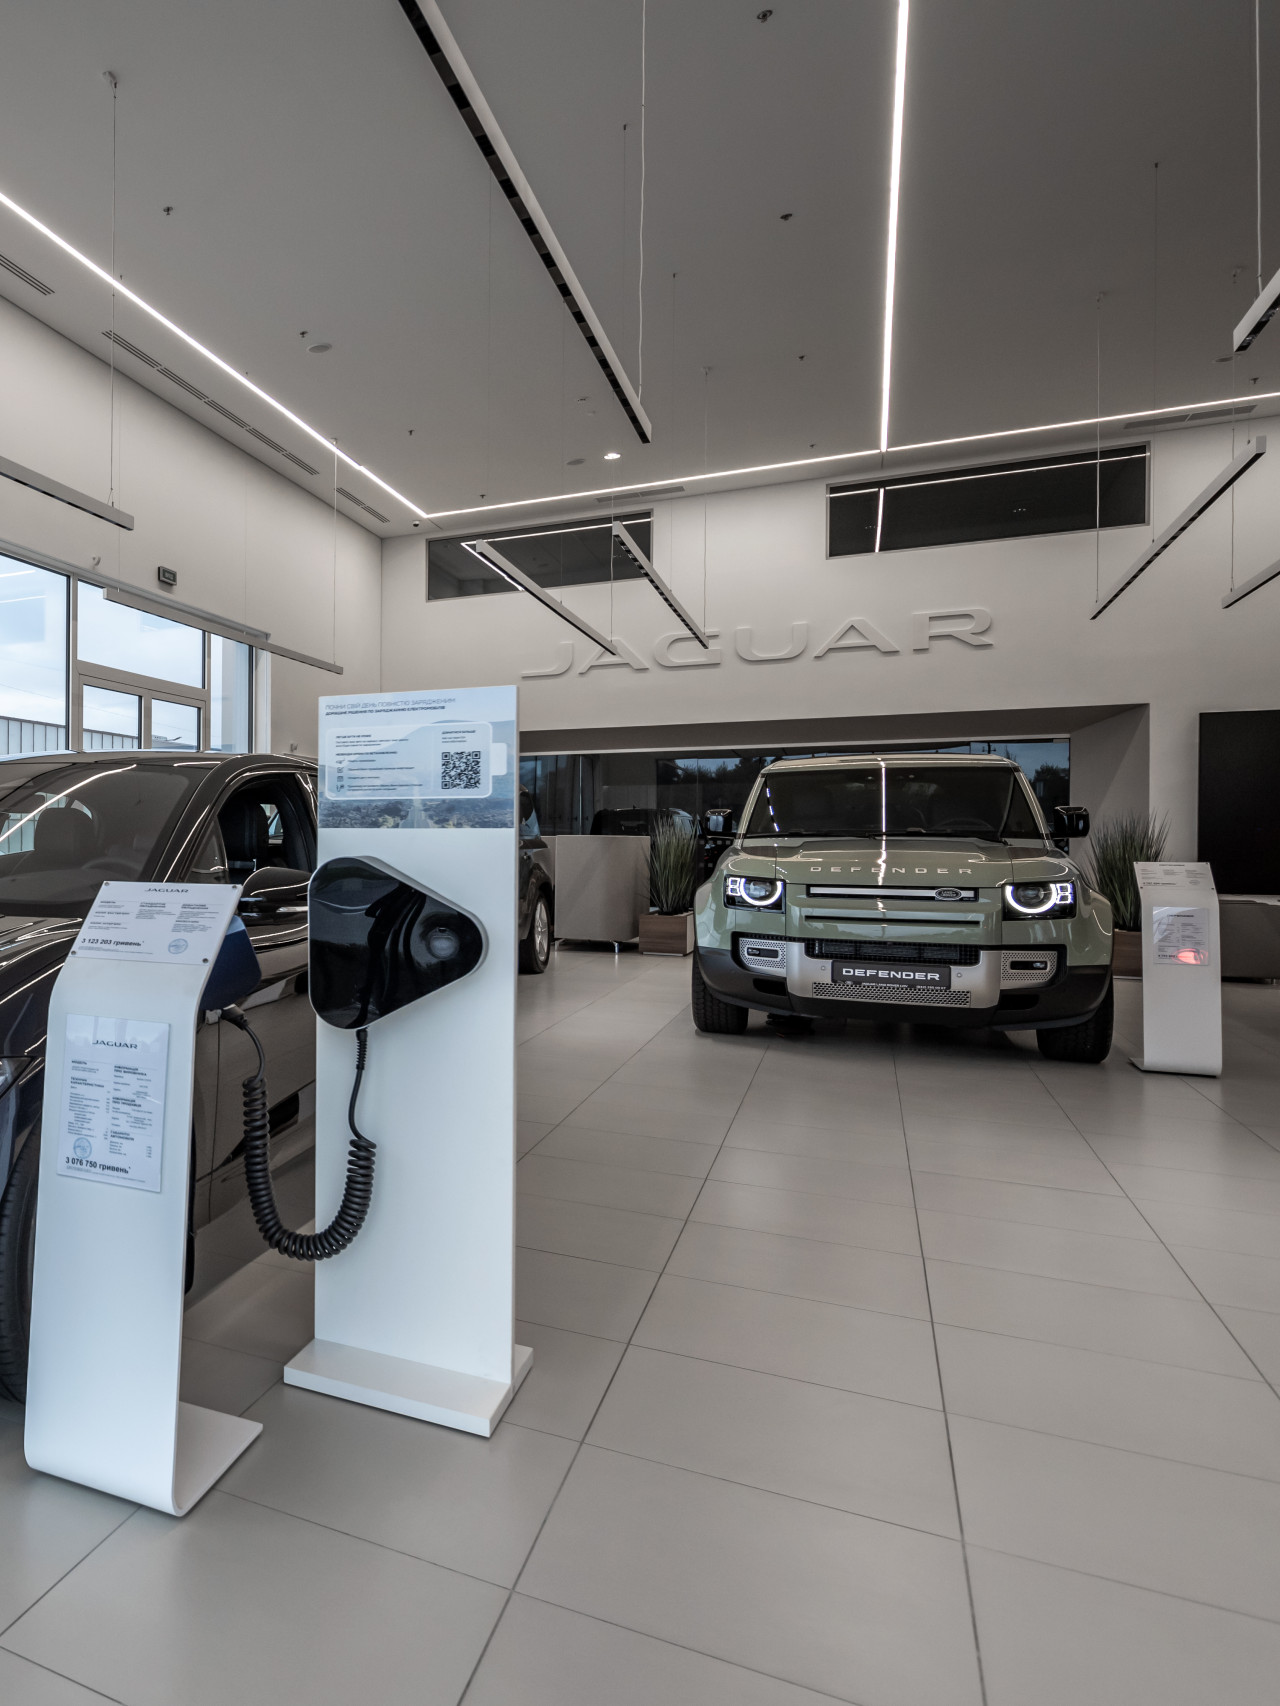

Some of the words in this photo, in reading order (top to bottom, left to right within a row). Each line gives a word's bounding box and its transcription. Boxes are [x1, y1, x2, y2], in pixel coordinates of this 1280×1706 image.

[521, 607, 993, 678] JAGUAR
[810, 866, 972, 874] DEFENDER
[842, 968, 940, 980] DEFENDER
[92, 1040, 138, 1049] JAGUAR
[65, 1156, 70, 1164] 3
[71, 1158, 83, 1166] 076
[85, 1160, 97, 1168] 750
